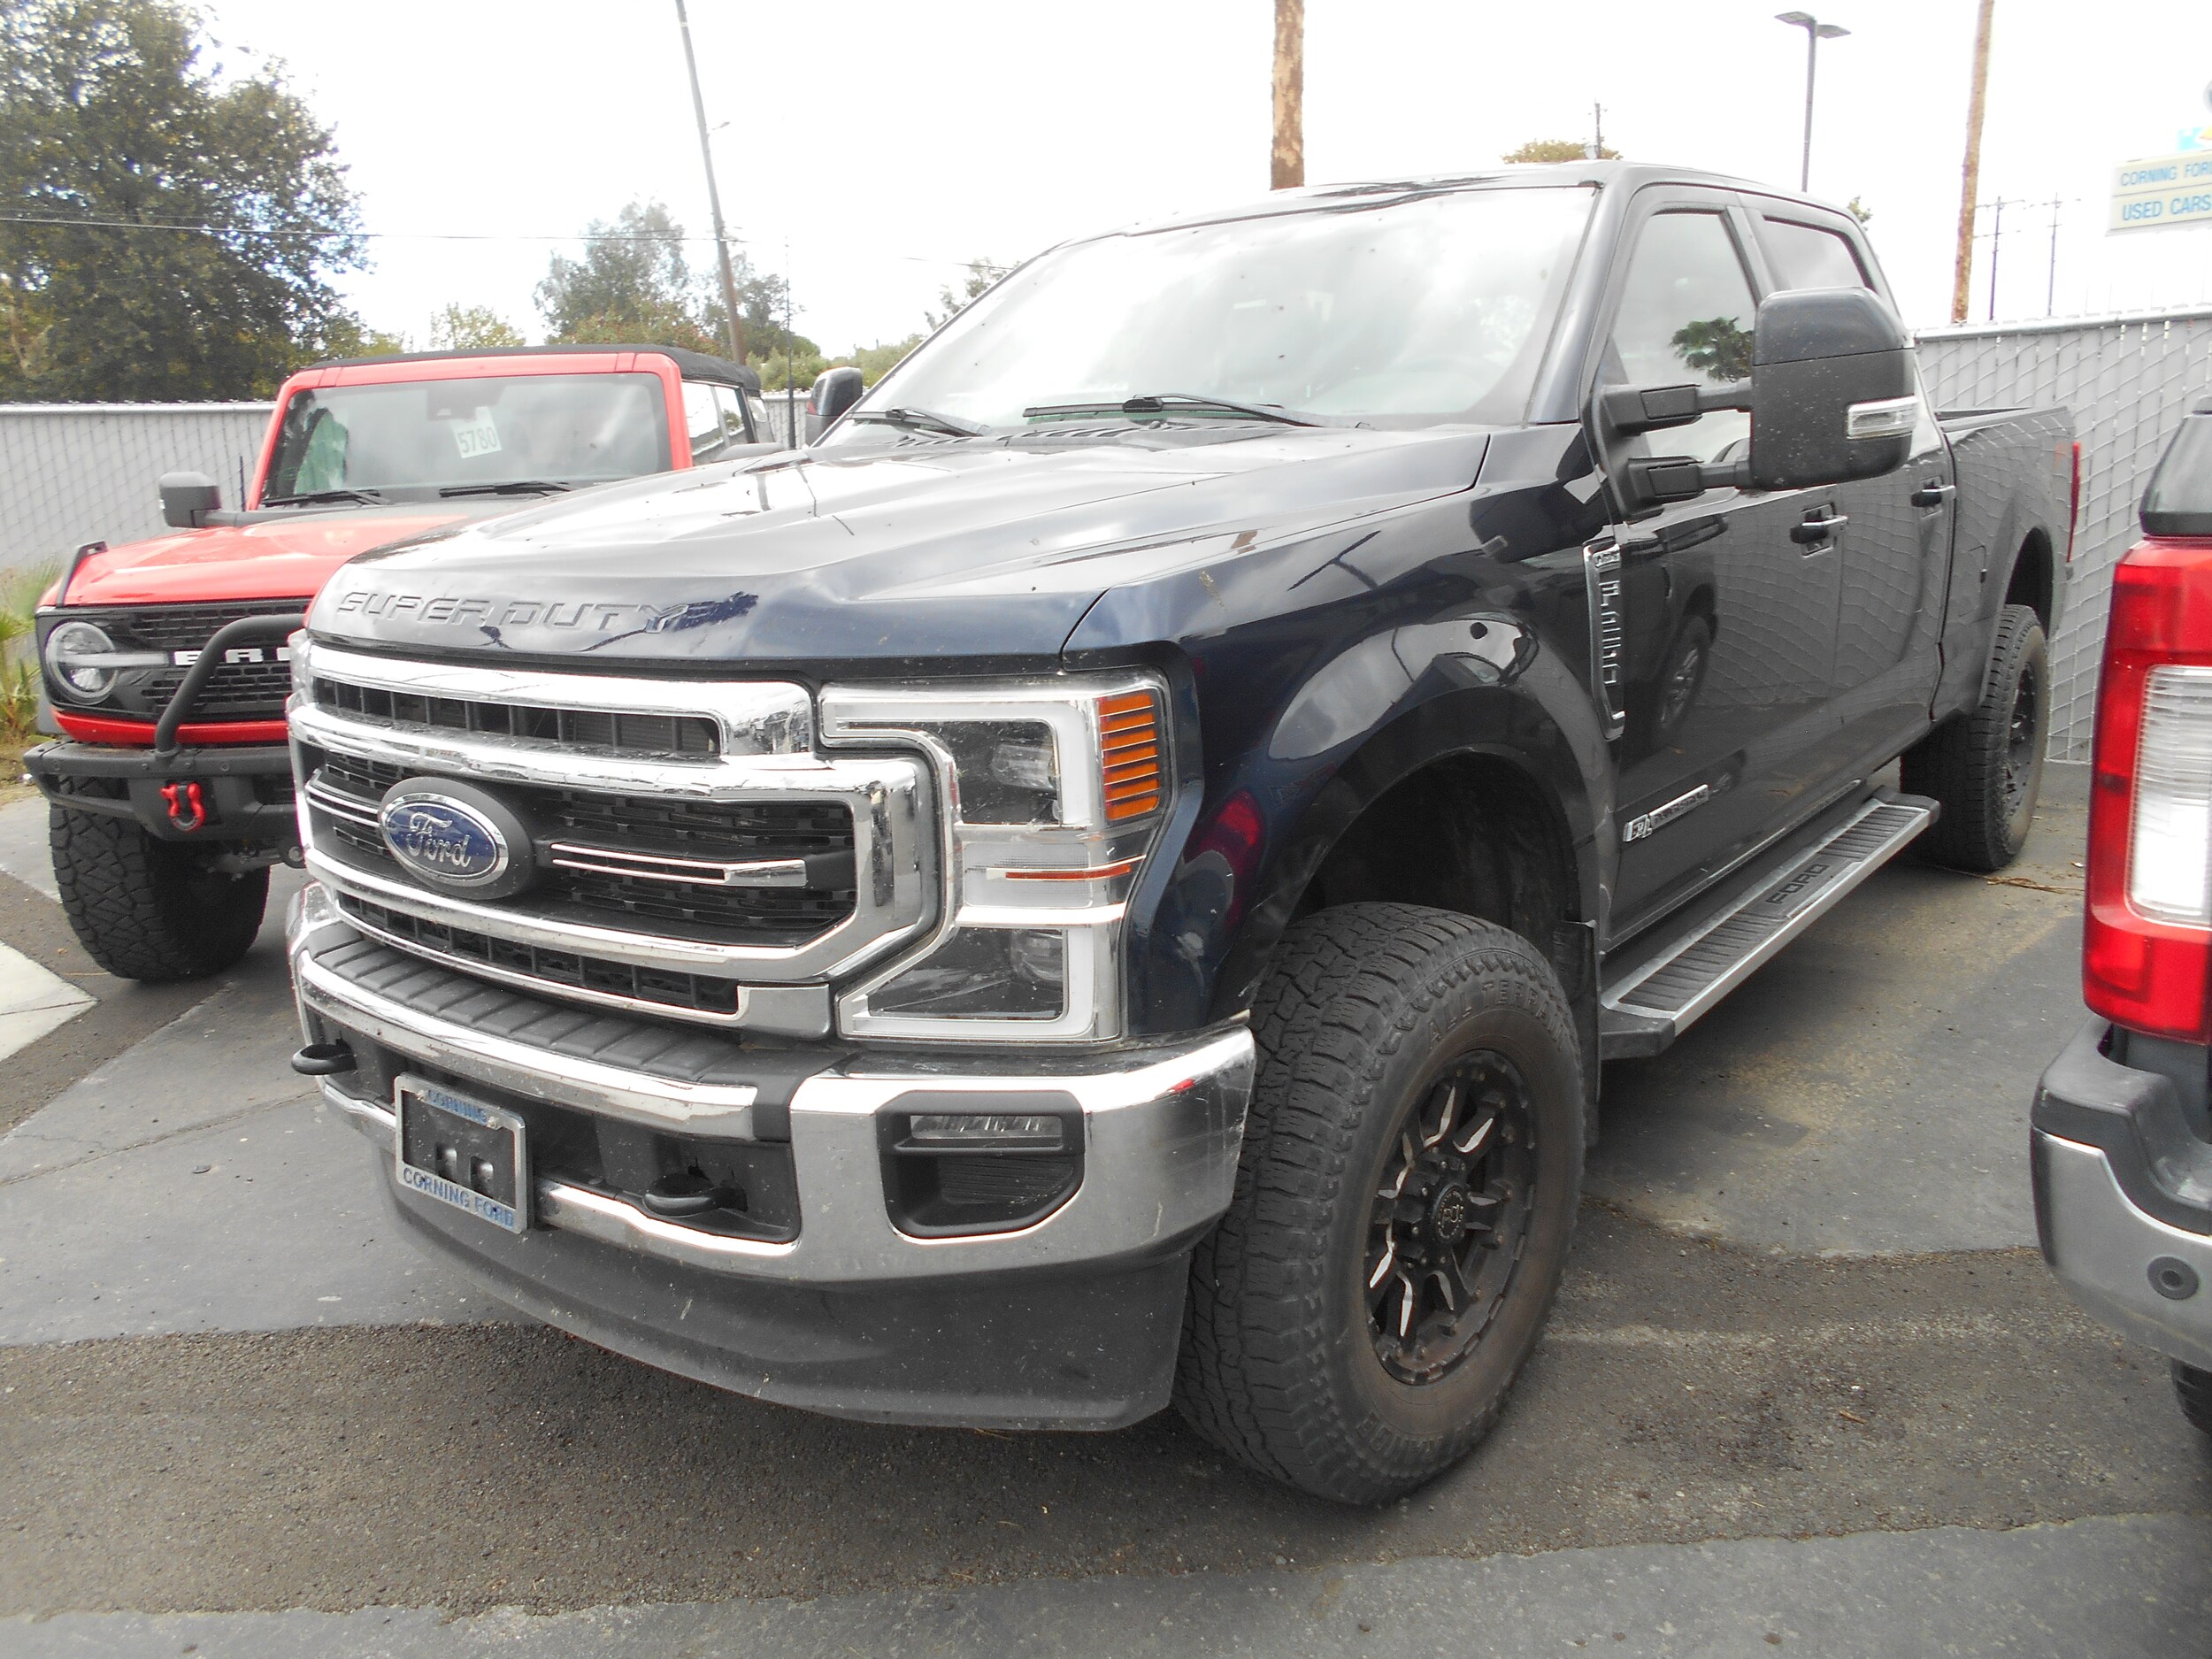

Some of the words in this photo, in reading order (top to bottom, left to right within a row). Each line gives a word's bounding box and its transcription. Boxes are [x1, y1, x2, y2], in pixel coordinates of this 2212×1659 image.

[2120, 166, 2177, 187] CORNING
[2123, 201, 2162, 221] USED
[2170, 194, 2212, 215] CARS
[457, 426, 497, 454] 5780
[337, 591, 492, 626] SUPER
[497, 602, 689, 634] DUTY
[406, 811, 472, 867] Ford
[1766, 864, 1830, 903] FORD
[403, 1167, 470, 1208] CORNING
[475, 1196, 514, 1227] FORD
